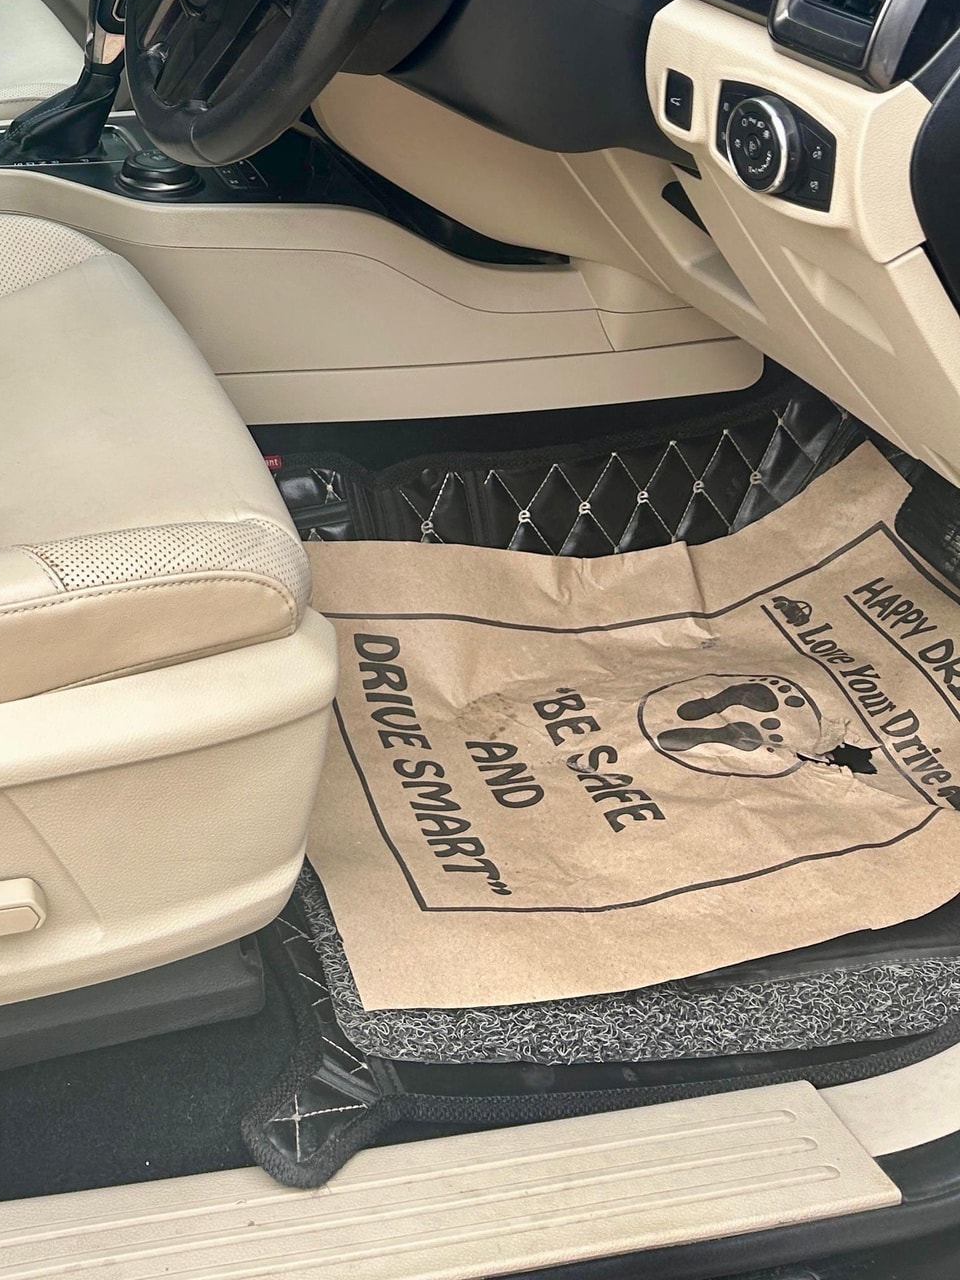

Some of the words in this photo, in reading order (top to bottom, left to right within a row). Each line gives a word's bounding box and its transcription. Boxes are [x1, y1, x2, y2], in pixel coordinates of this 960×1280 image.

[852, 577, 938, 640] HAPPY
[353, 633, 432, 750] DRIVE
[797, 622, 855, 665] Love
[839, 664, 897, 718] Your
[879, 709, 952, 786] Drive
[465, 741, 545, 808] AND
[565, 744, 666, 833] SAFE
